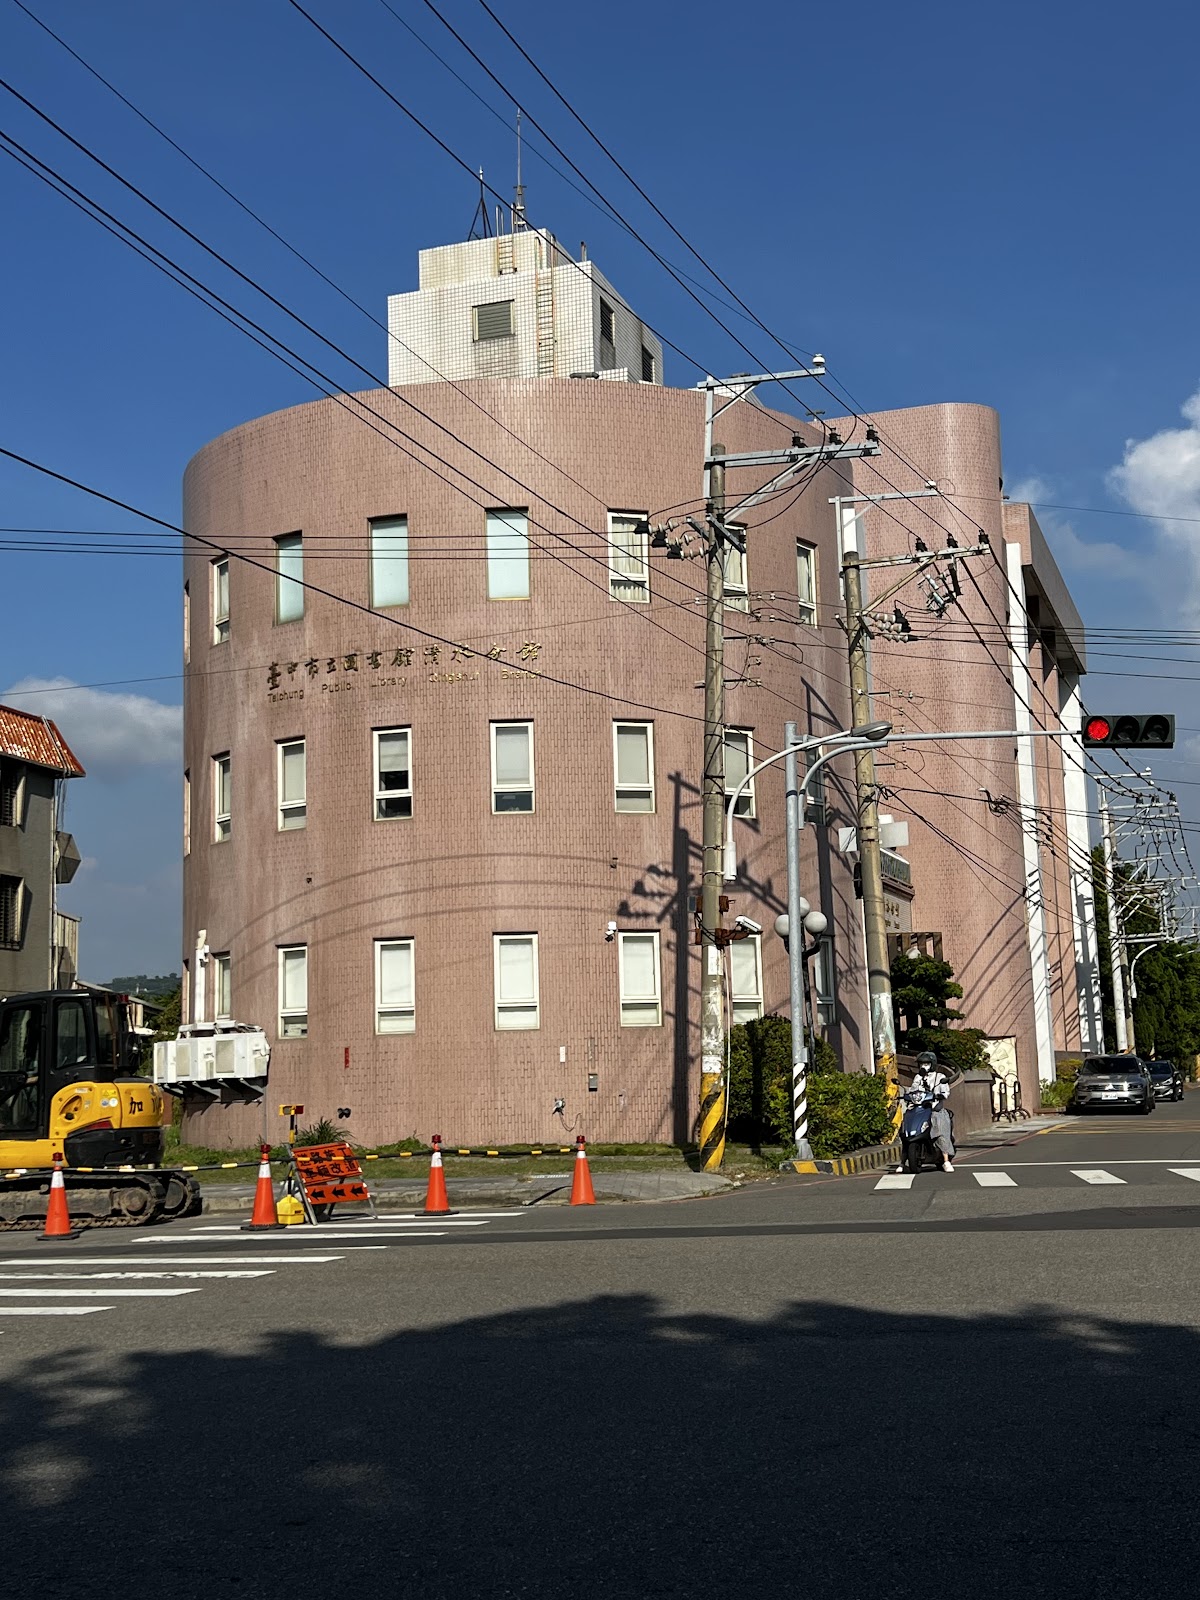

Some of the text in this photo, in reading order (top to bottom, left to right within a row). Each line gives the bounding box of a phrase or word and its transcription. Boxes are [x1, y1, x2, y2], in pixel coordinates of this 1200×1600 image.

[267, 668, 543, 703] Taichung Public Library Qingshui Branch
